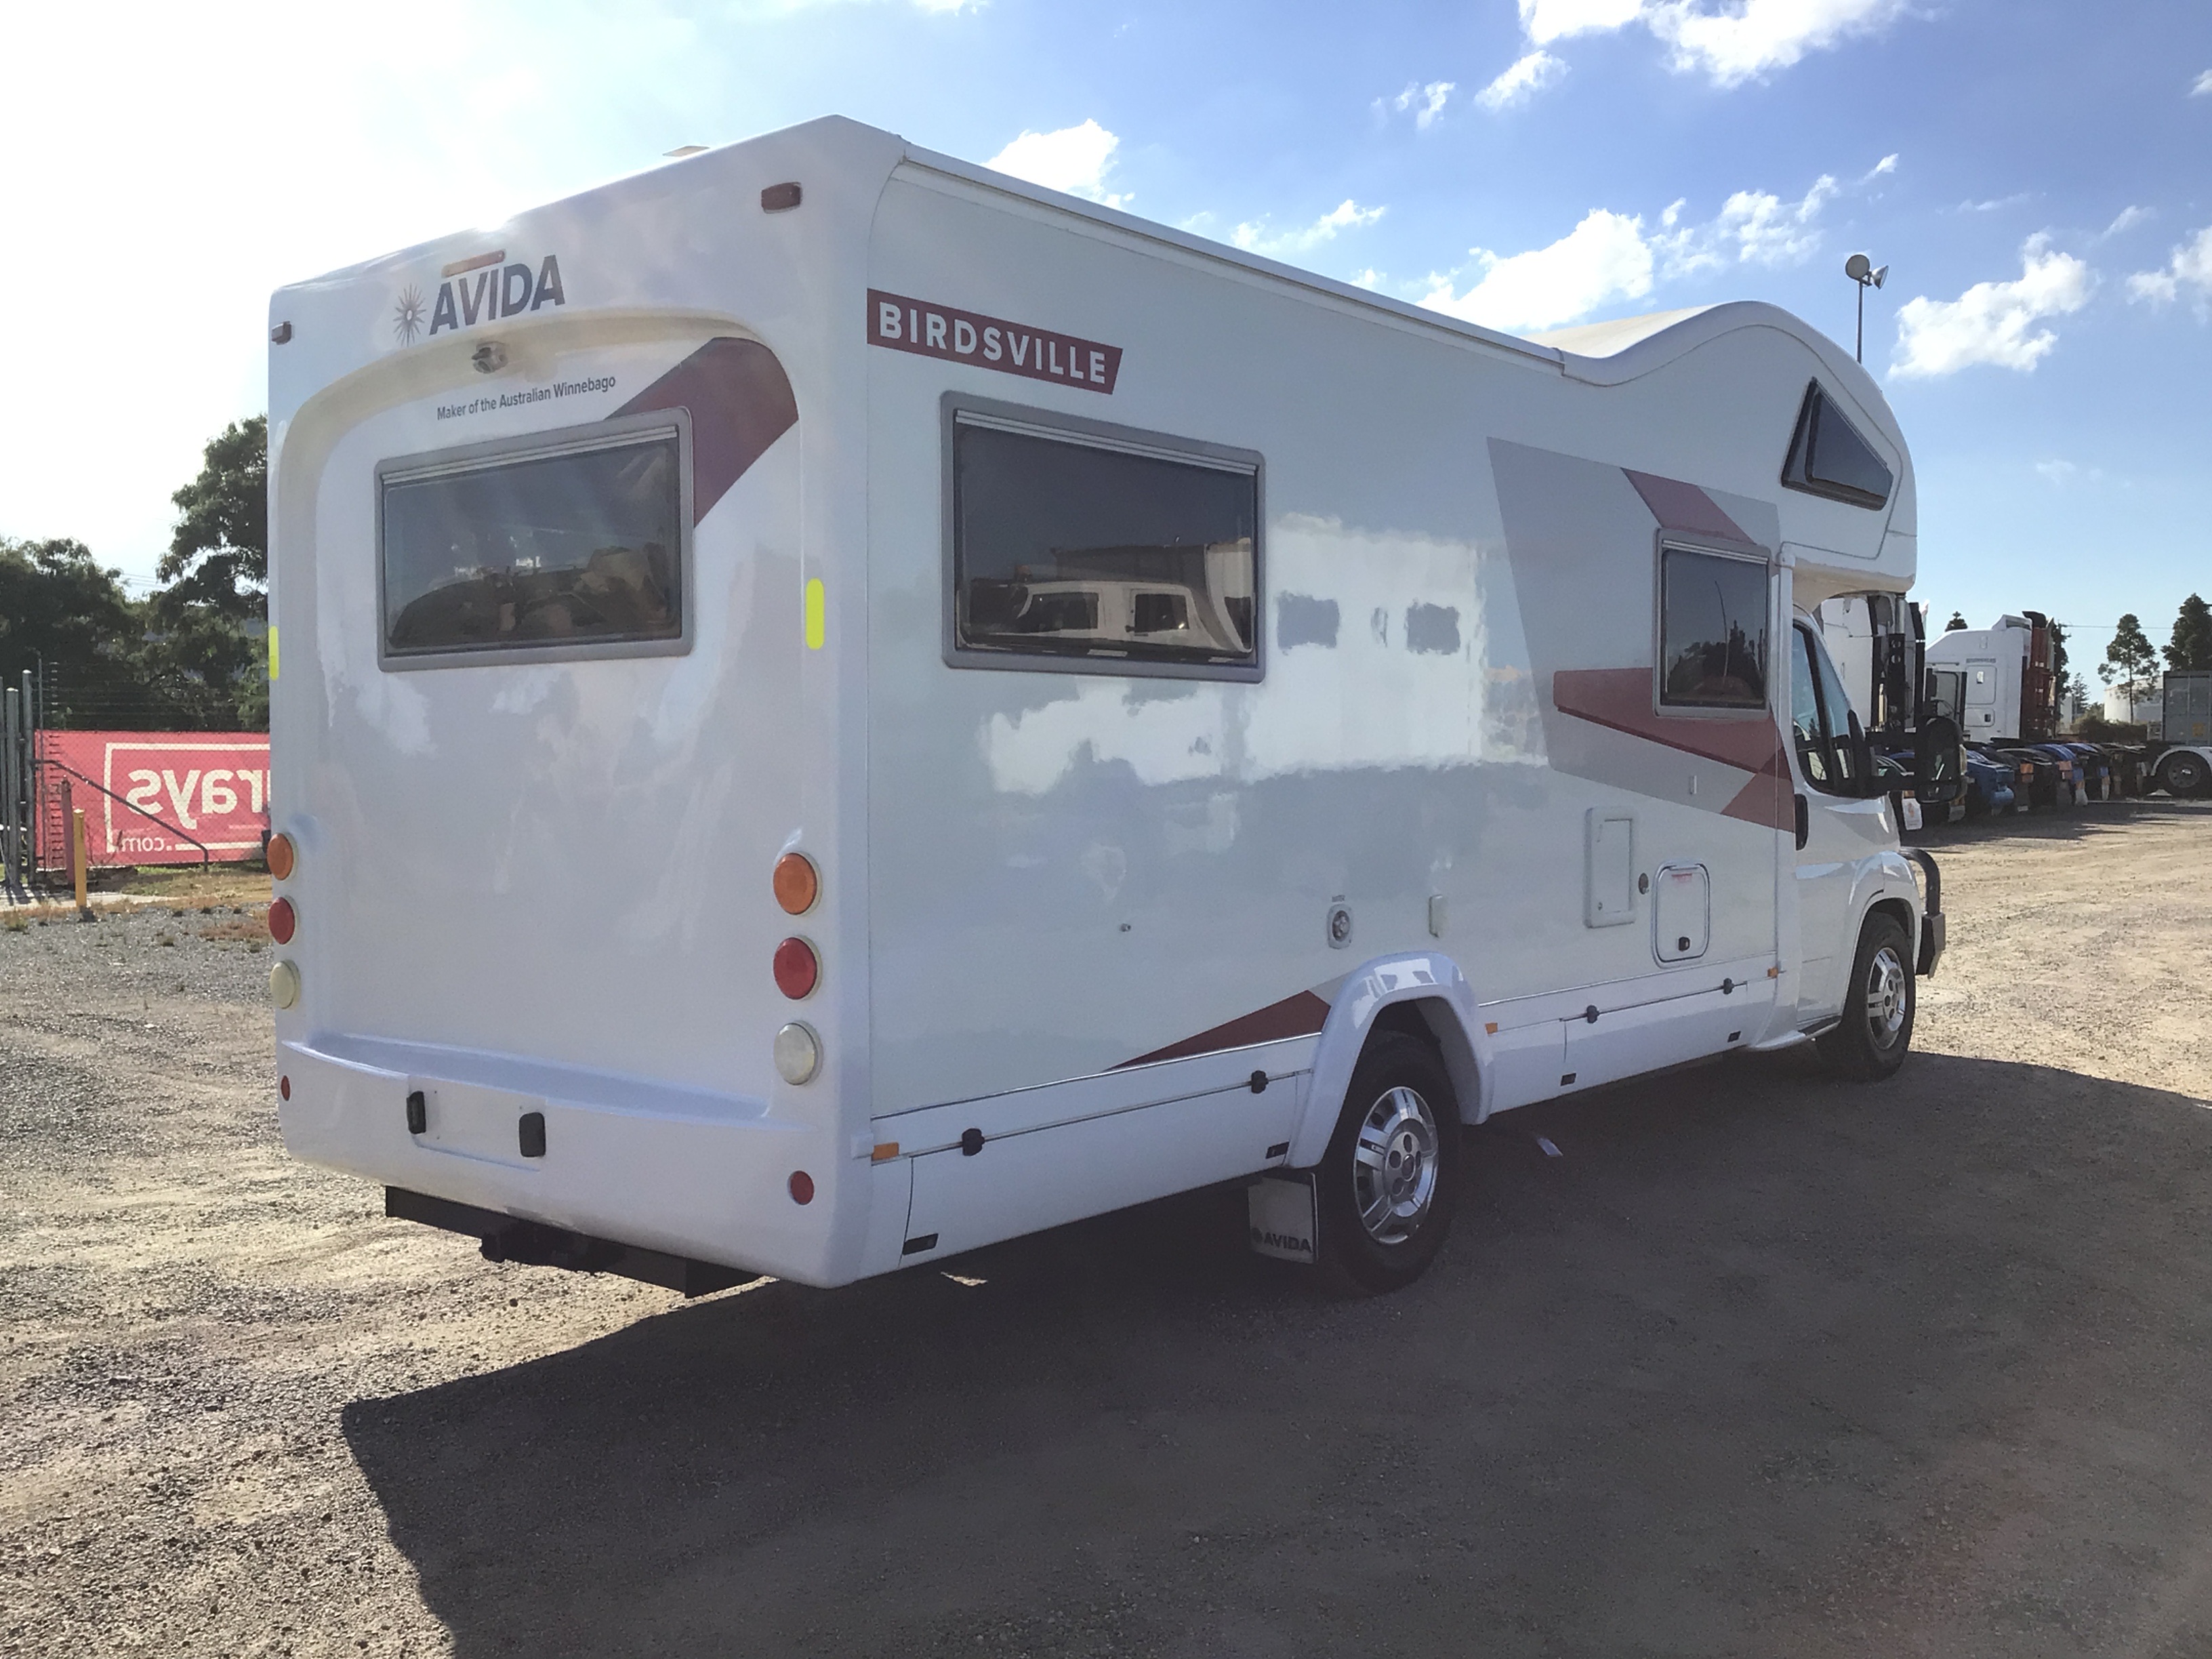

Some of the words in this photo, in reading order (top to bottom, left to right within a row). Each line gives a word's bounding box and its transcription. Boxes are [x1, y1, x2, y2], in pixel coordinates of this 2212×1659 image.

[429, 254, 566, 336] AVIDA
[879, 302, 1106, 384] BIRDSVILLE
[437, 405, 466, 420] Maker
[468, 398, 479, 414] of
[480, 398, 497, 411] the
[499, 387, 551, 409] Australian
[553, 376, 616, 398] Winnebago
[1263, 1233, 1312, 1252] AVIDA
